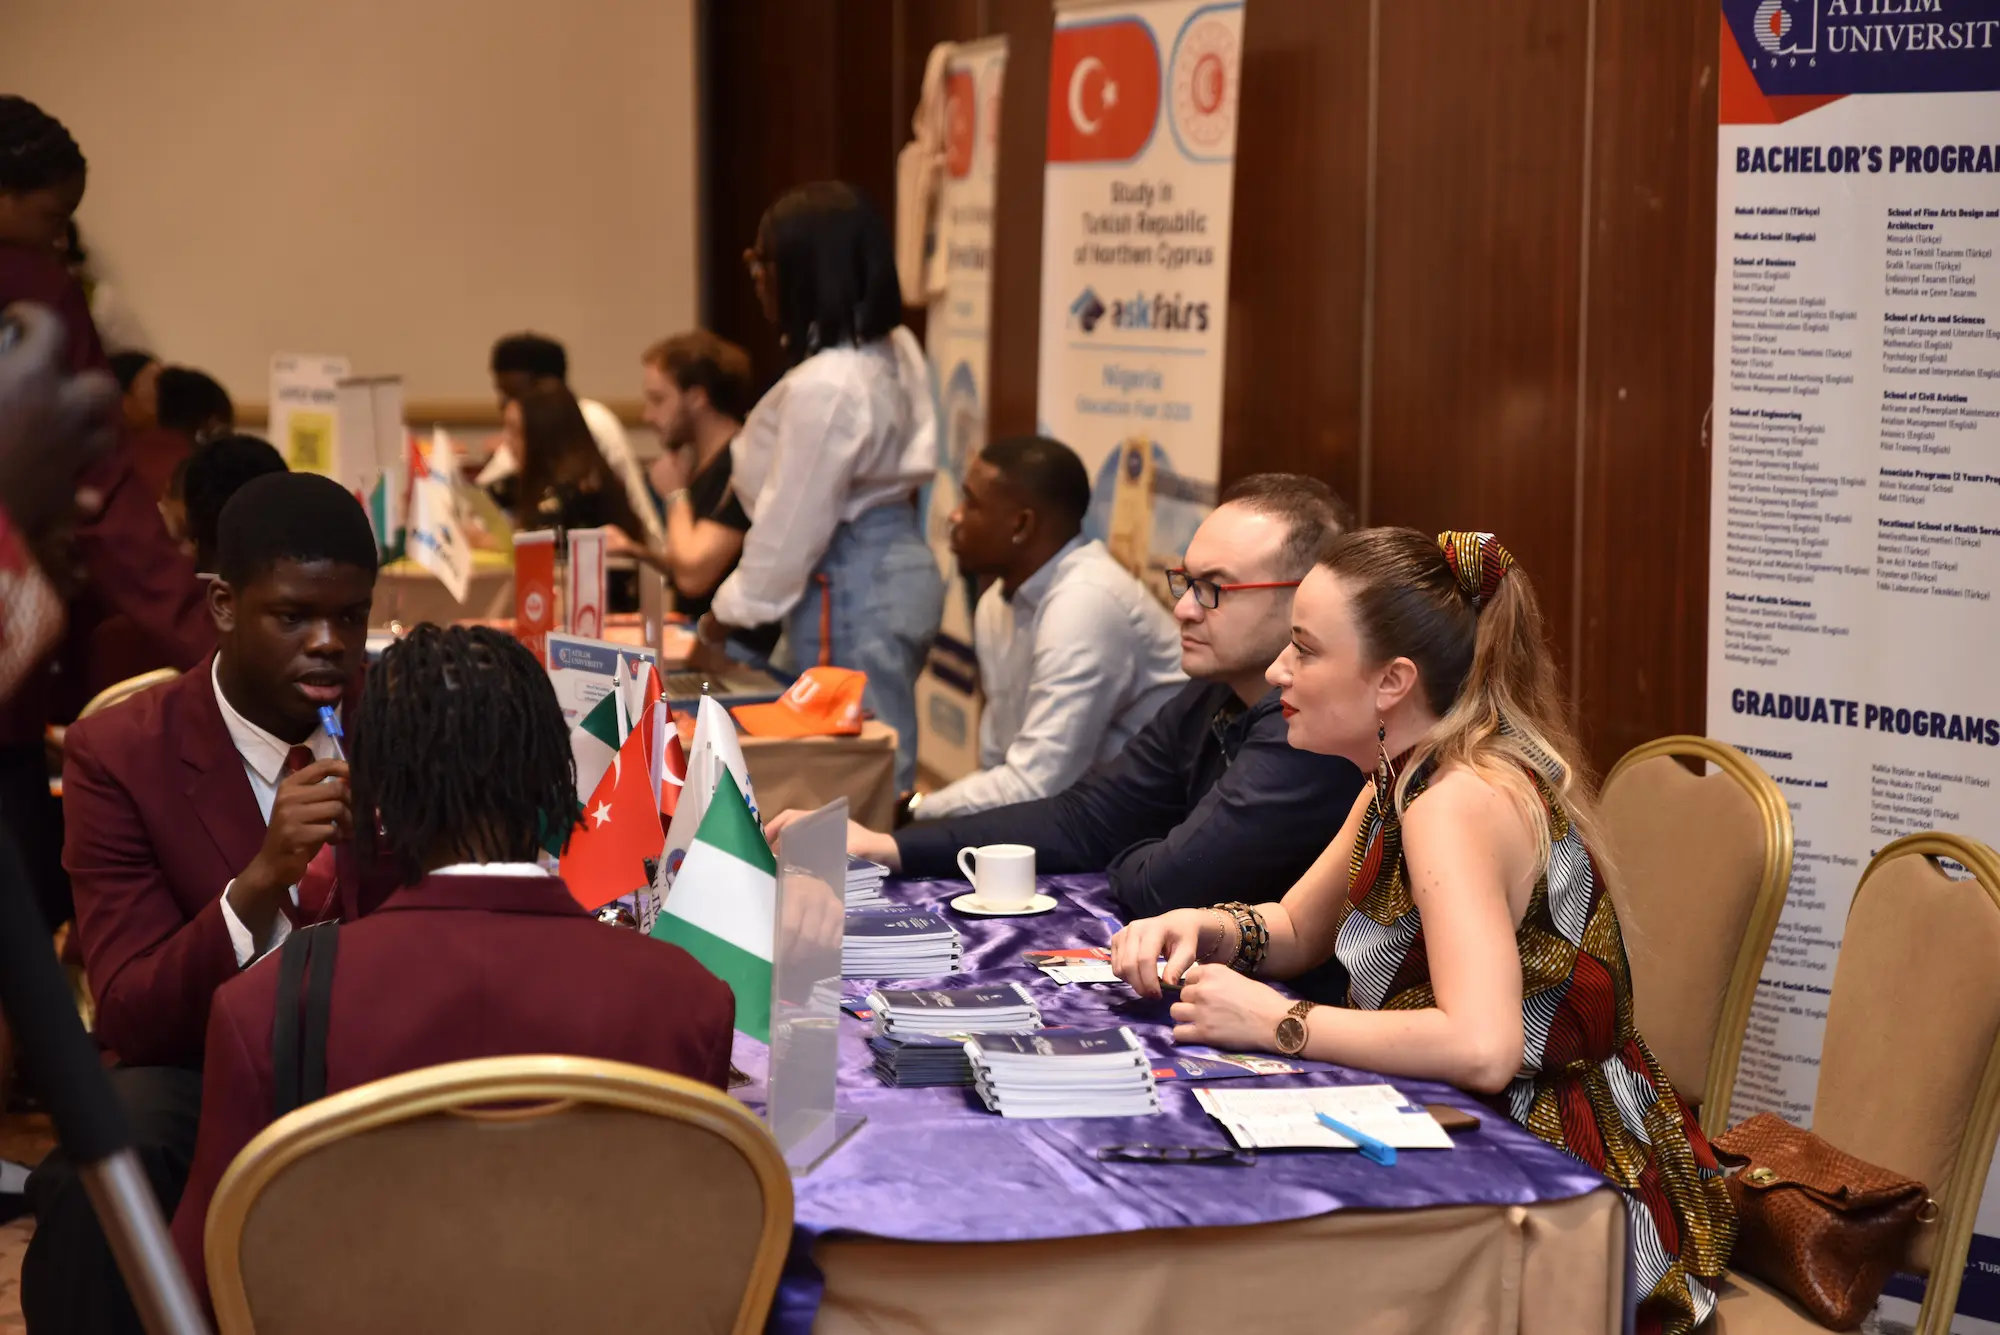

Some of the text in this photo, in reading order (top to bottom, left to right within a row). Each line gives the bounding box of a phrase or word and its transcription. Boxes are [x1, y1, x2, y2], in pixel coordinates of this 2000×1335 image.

[1736, 145, 1883, 174] BACHELOR'S
[1888, 208, 1999, 219] School of Fine Arts Design and
[1136, 209, 1206, 236] Republic
[1887, 221, 1934, 230] Architecture
[1884, 312, 1985, 324] School of Arts and Sciences
[1884, 390, 1968, 403] School of Civil Aviation
[1917, 520, 1942, 531] School
[1732, 687, 2000, 747] GRADUATE PROGRAMS
